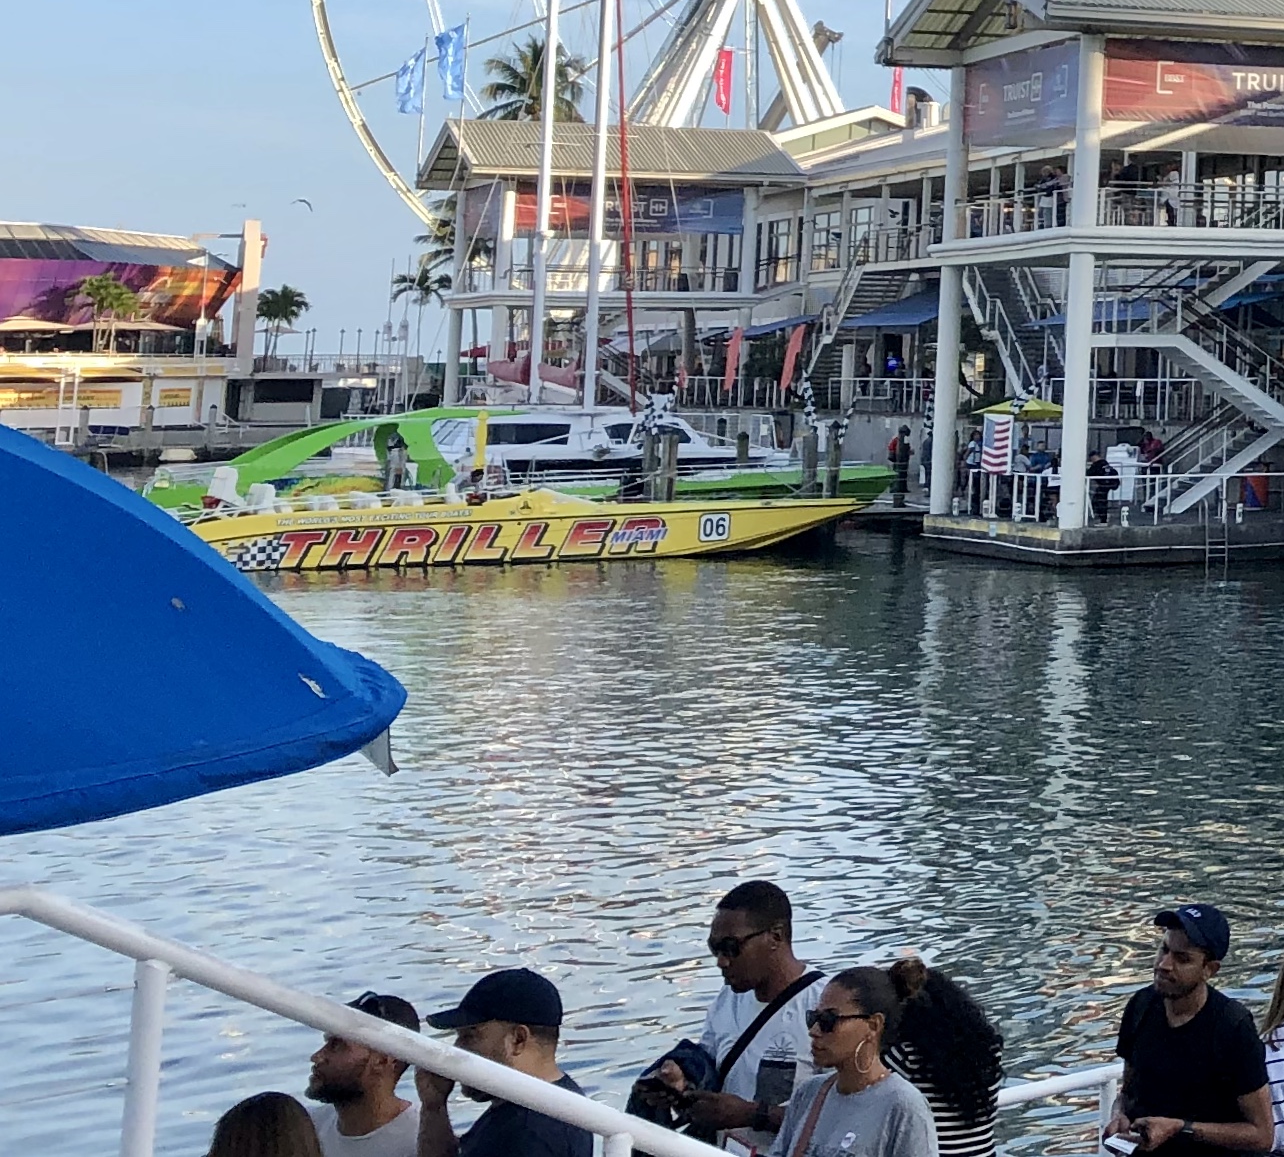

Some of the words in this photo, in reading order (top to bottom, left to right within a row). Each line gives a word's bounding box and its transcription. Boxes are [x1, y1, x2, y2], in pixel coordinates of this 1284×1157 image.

[1003, 80, 1031, 102] TRUIST
[276, 518, 294, 527] THE
[297, 516, 339, 526] WORLD'S
[341, 515, 366, 524] MOST
[368, 512, 412, 523] EXCITING
[414, 511, 439, 521] TOUR
[702, 516, 727, 538] 06
[276, 516, 667, 572] THRILLER
[610, 527, 669, 545] MIAMI
